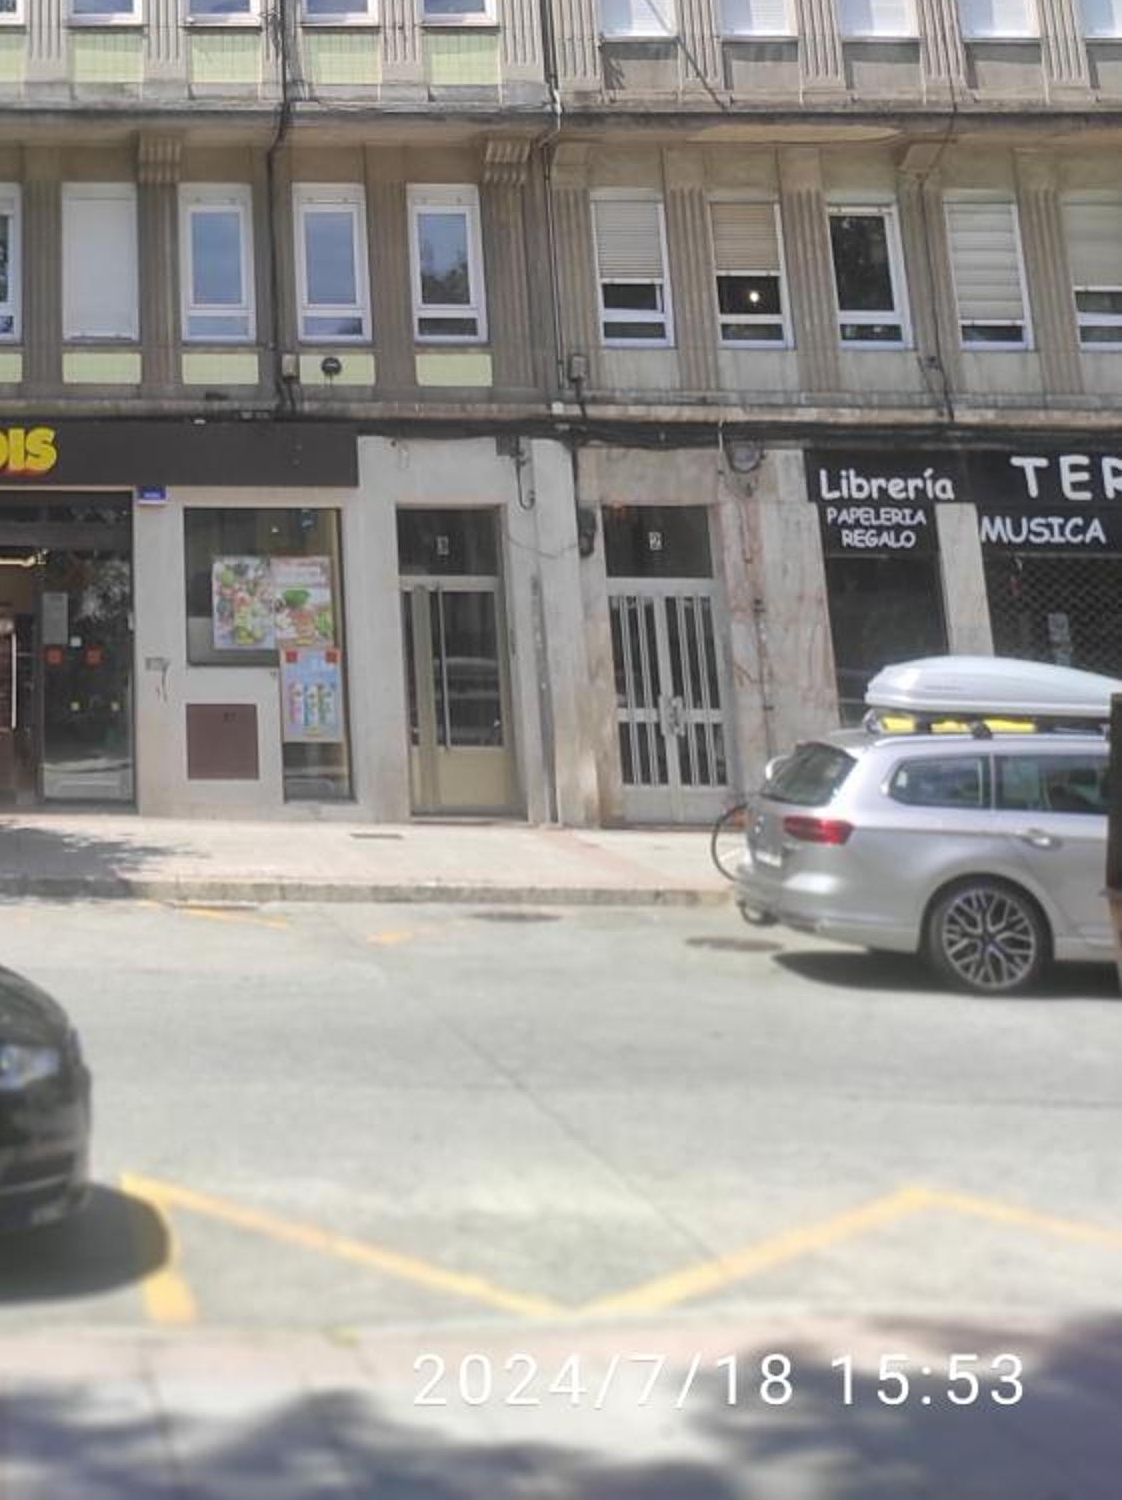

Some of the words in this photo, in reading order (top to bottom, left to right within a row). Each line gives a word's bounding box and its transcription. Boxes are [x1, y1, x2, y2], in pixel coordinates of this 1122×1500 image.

[819, 467, 955, 501] Librería
[827, 506, 927, 526] PAPELERIA
[841, 529, 917, 548] REGALO
[980, 516, 1107, 545] MUSICA
